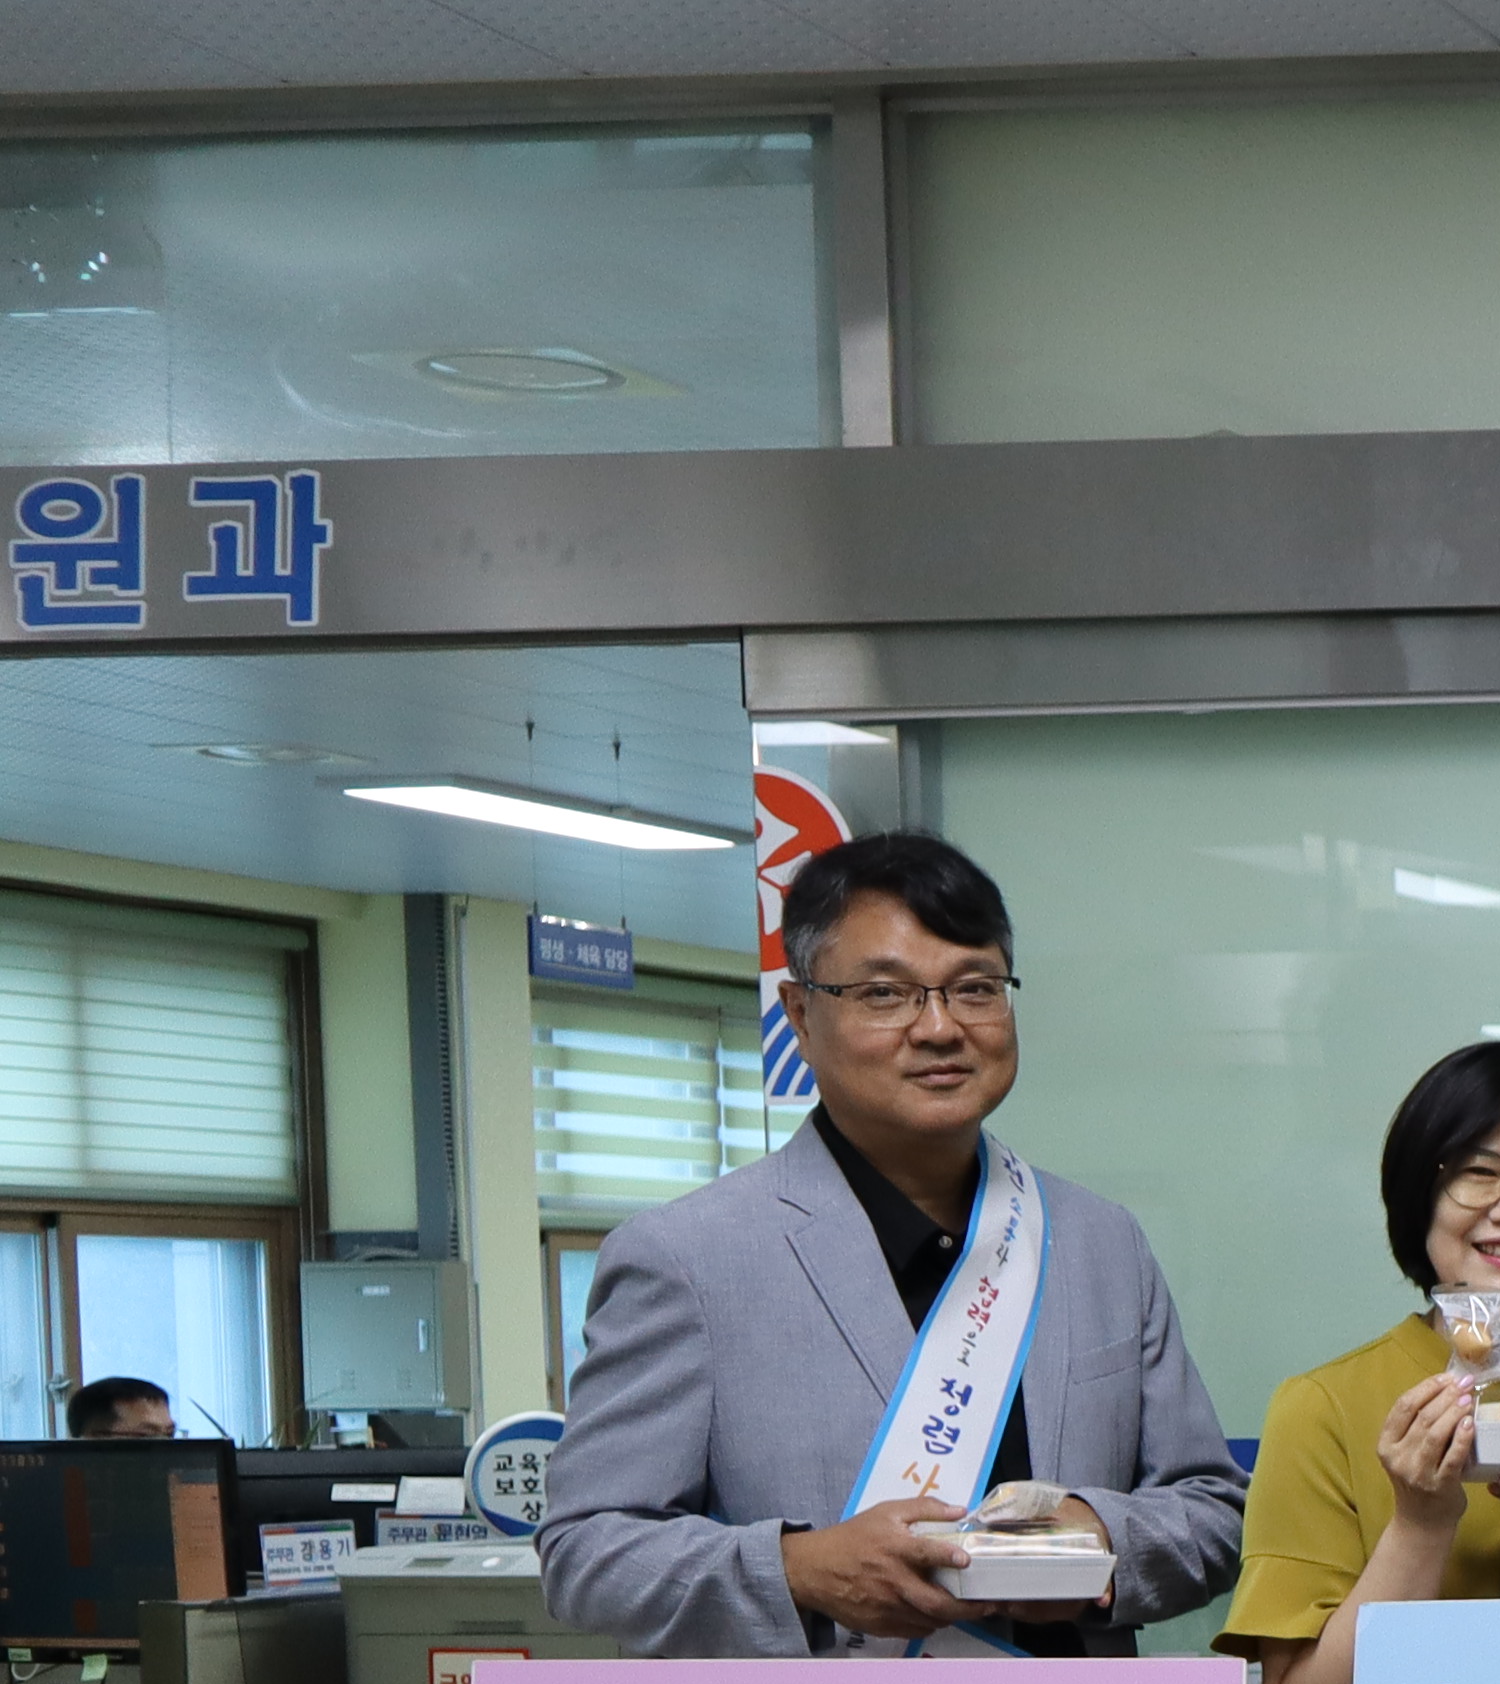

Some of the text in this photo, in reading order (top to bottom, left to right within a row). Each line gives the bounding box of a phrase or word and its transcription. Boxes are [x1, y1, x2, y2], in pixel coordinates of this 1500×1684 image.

[9, 468, 333, 630] 원과
[922, 1376, 974, 1456] 청렴
[493, 1452, 551, 1474] 교육
[493, 1477, 543, 1497] 보호
